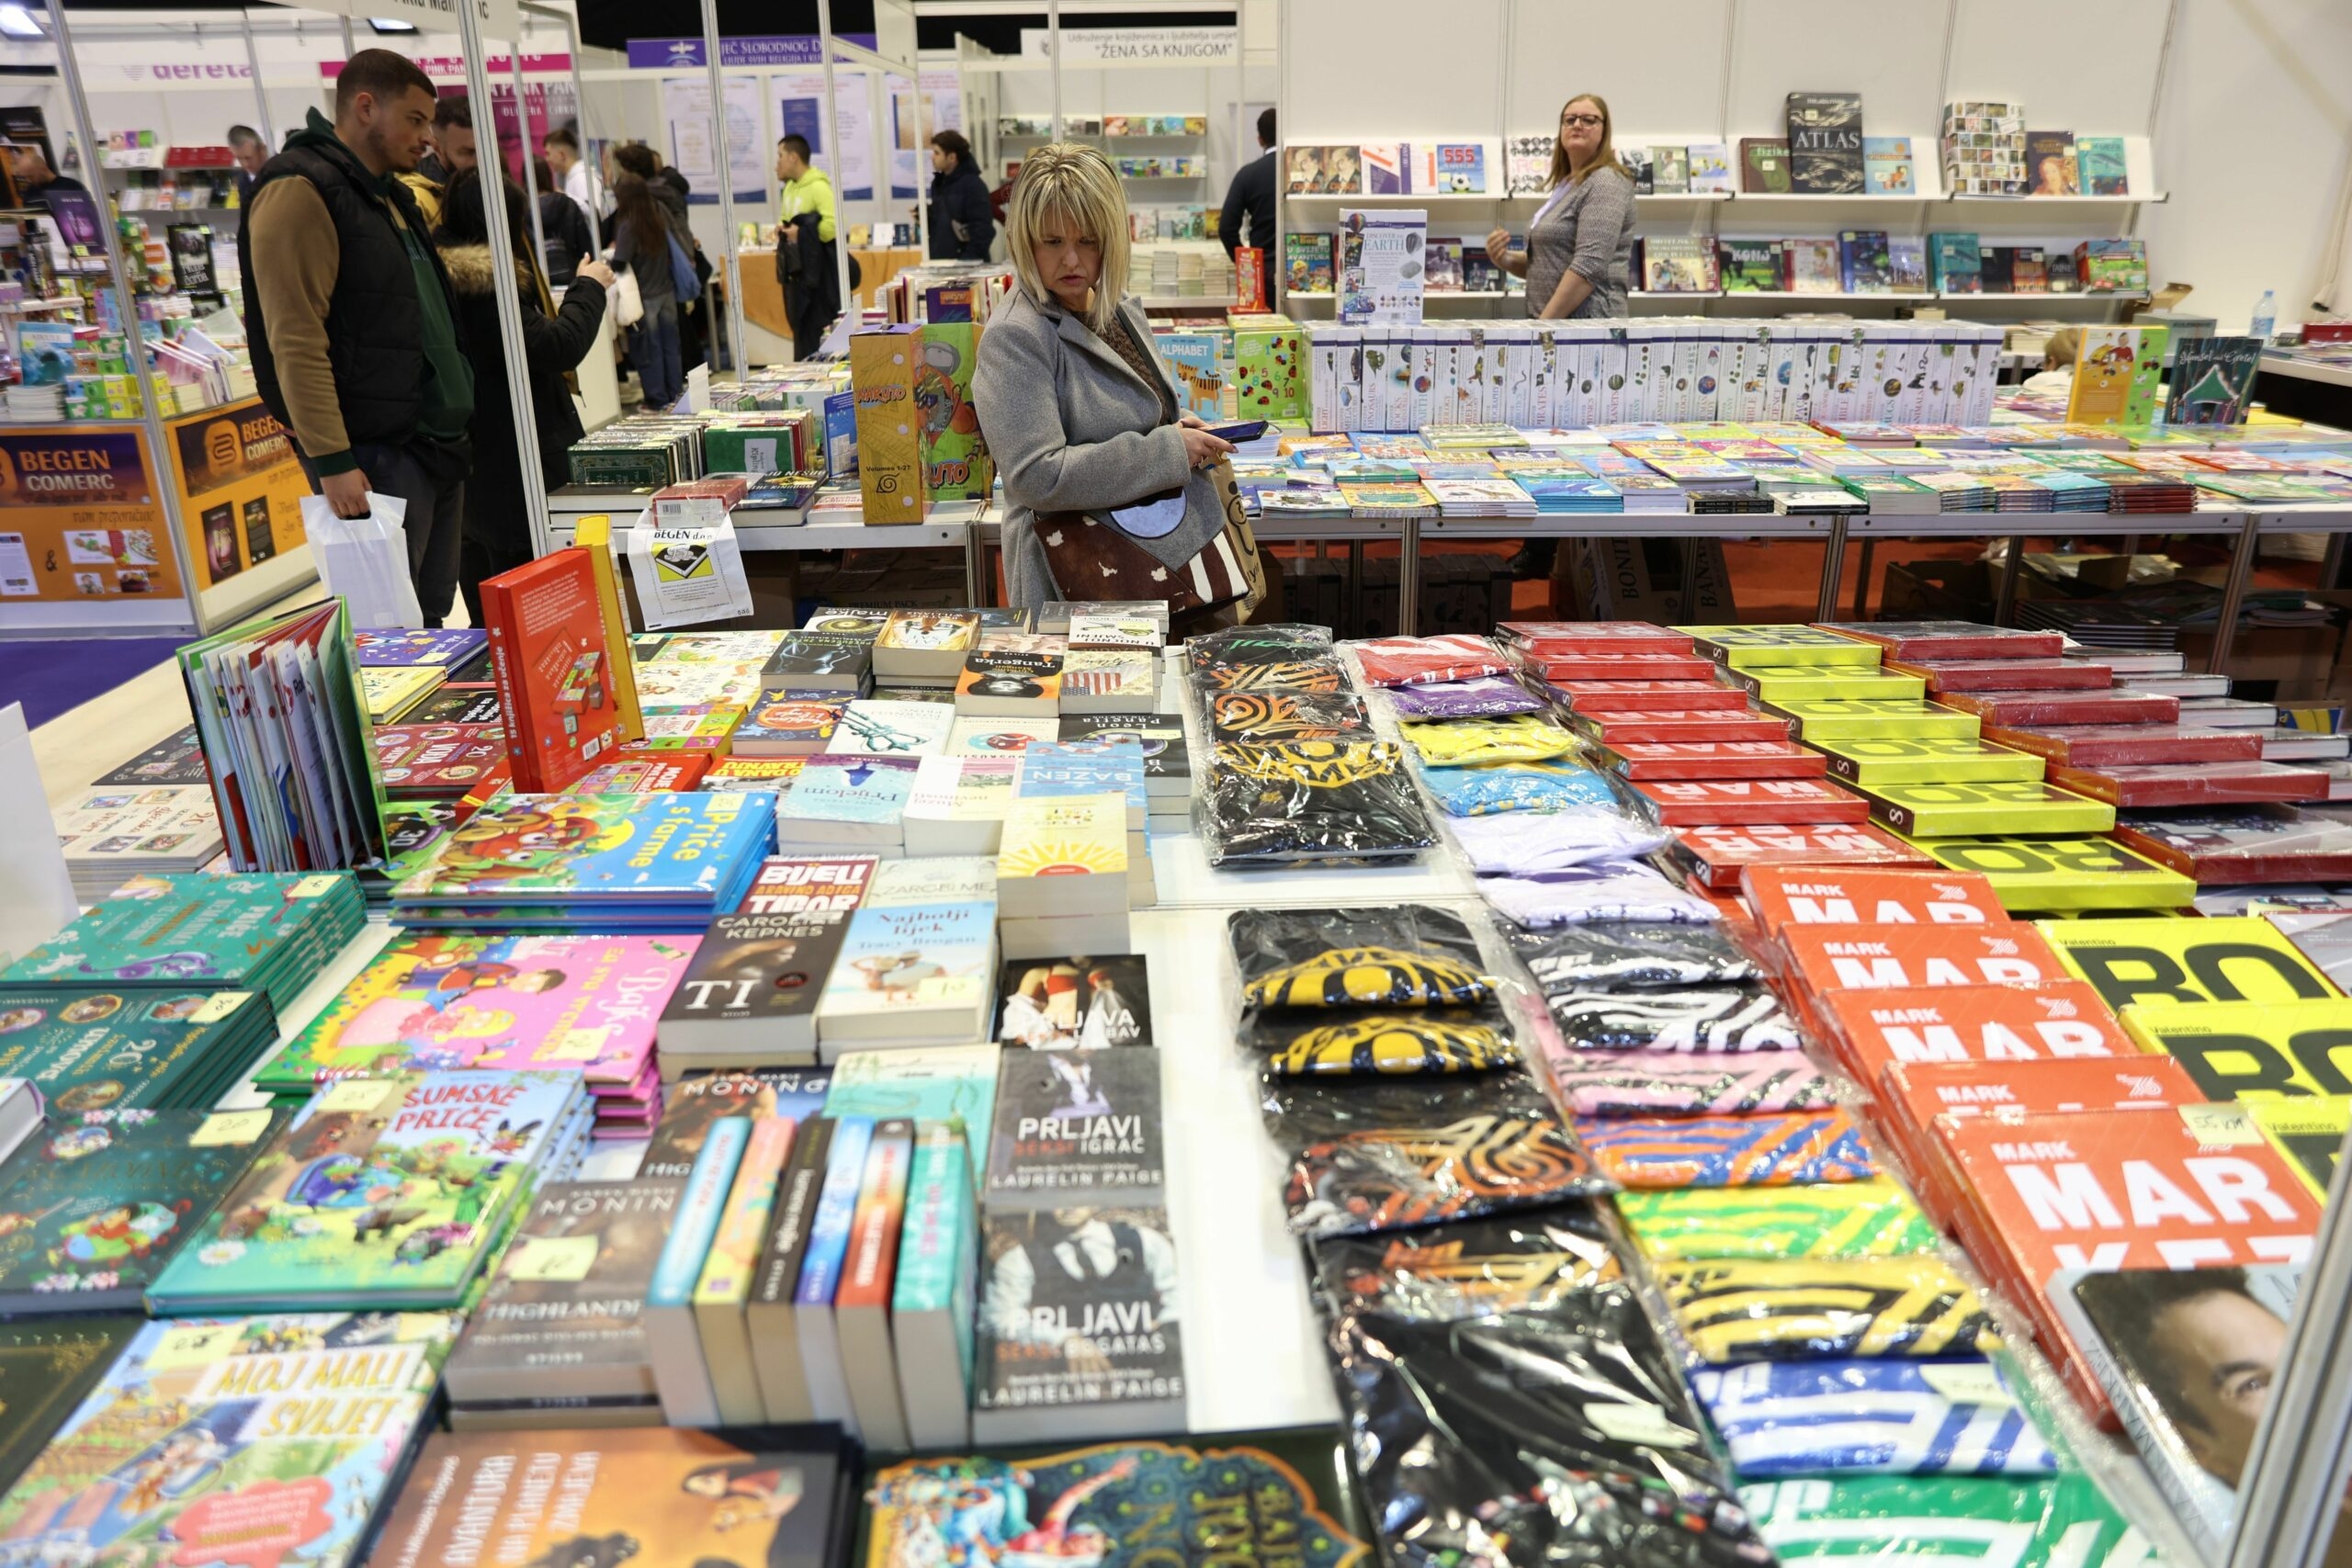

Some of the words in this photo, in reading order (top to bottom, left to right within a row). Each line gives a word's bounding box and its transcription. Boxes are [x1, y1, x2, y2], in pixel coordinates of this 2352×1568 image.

[741, 40, 808, 54] SLOBODNOG
[1142, 44, 1159, 58] SA
[1796, 131, 1861, 149] ATLAS
[1443, 147, 1475, 163] 555
[1757, 147, 1791, 157] fizike
[1364, 239, 1405, 251] EARTH
[1161, 344, 1209, 357] ALPHABET
[1265, 345, 1271, 355] 1
[1290, 353, 1295, 363] 3
[2179, 351, 2213, 363] Hansel
[2224, 351, 2256, 363] Gretel
[1250, 364, 1256, 374] 4
[1261, 367, 1268, 378] 5
[1274, 370, 1281, 381] 6
[1251, 376, 1260, 387] 8
[1283, 378, 1289, 387] 7
[856, 384, 907, 404] NARUTO
[1272, 387, 1279, 397] 9
[1284, 387, 1295, 399] 10
[1419, 394, 1428, 424] ARTH
[1772, 386, 1781, 421] CIENCE
[1838, 398, 1849, 420] IBLE
[1344, 407, 1352, 430] MEGA
[242, 415, 284, 442] BEGEN
[244, 436, 288, 460] COMERC
[19, 449, 111, 470] BEGEN
[26, 473, 115, 491] COMERC
[825, 609, 888, 617] majke
[494, 646, 509, 678] učenje
[974, 657, 1055, 669] Tangerka
[501, 679, 509, 690] za
[502, 692, 516, 728] knjižica
[509, 728, 517, 739] 15
[413, 743, 460, 764] VODA
[722, 761, 805, 770] TRAVNJU
[654, 767, 683, 788] MOJE
[1033, 770, 1132, 782] BAZEN
[804, 787, 898, 802] Prijelom
[670, 807, 693, 815] s
[390, 829, 427, 846] 30
[627, 818, 685, 868] farme
[672, 811, 731, 861] Priče
[1700, 834, 1883, 852] MAR
[760, 863, 865, 889] BIJELI
[755, 885, 811, 897] ARAVIND
[814, 883, 863, 896] ADIGA
[884, 882, 954, 897] ZAROBI
[958, 881, 989, 895] ME
[1782, 884, 1845, 897] MARK
[878, 908, 970, 926] Najbolji
[726, 923, 825, 940] KEPNES
[893, 921, 944, 937] lijek
[1824, 942, 1890, 956] MARK
[2060, 938, 2117, 947] Valentino
[596, 967, 672, 1037] Bajke
[684, 979, 761, 1010] TI
[1871, 1009, 1941, 1025] MARK
[2149, 1024, 2212, 1034] Valentino
[1880, 1021, 2111, 1061] MAR
[108, 1039, 157, 1066] 20
[1936, 1085, 2016, 1103] MARK
[394, 1104, 497, 1134] PRIČE
[1018, 1114, 1142, 1141] PRLJAVI
[2267, 1121, 2336, 1134] Valentino
[1991, 1142, 2076, 1162] MARK
[990, 1172, 1093, 1189] LAURELIN
[1102, 1169, 1163, 1186] PAIGE
[2004, 1156, 2299, 1231] MAR
[538, 1192, 677, 1215] MONIN
[1007, 1301, 1153, 1339] PRLJAVI
[210, 1357, 308, 1396] MOJ
[312, 1351, 408, 1390] MALI
[979, 1383, 1101, 1409] LAURELIN
[1110, 1377, 1182, 1400] PAIGE
[261, 1397, 399, 1438] SVIJET
[503, 1452, 562, 1532] PLANETU
[547, 1451, 601, 1533] ZMAJEVA
[440, 1455, 517, 1565] AVANTURA
[497, 1534, 532, 1564] NA
